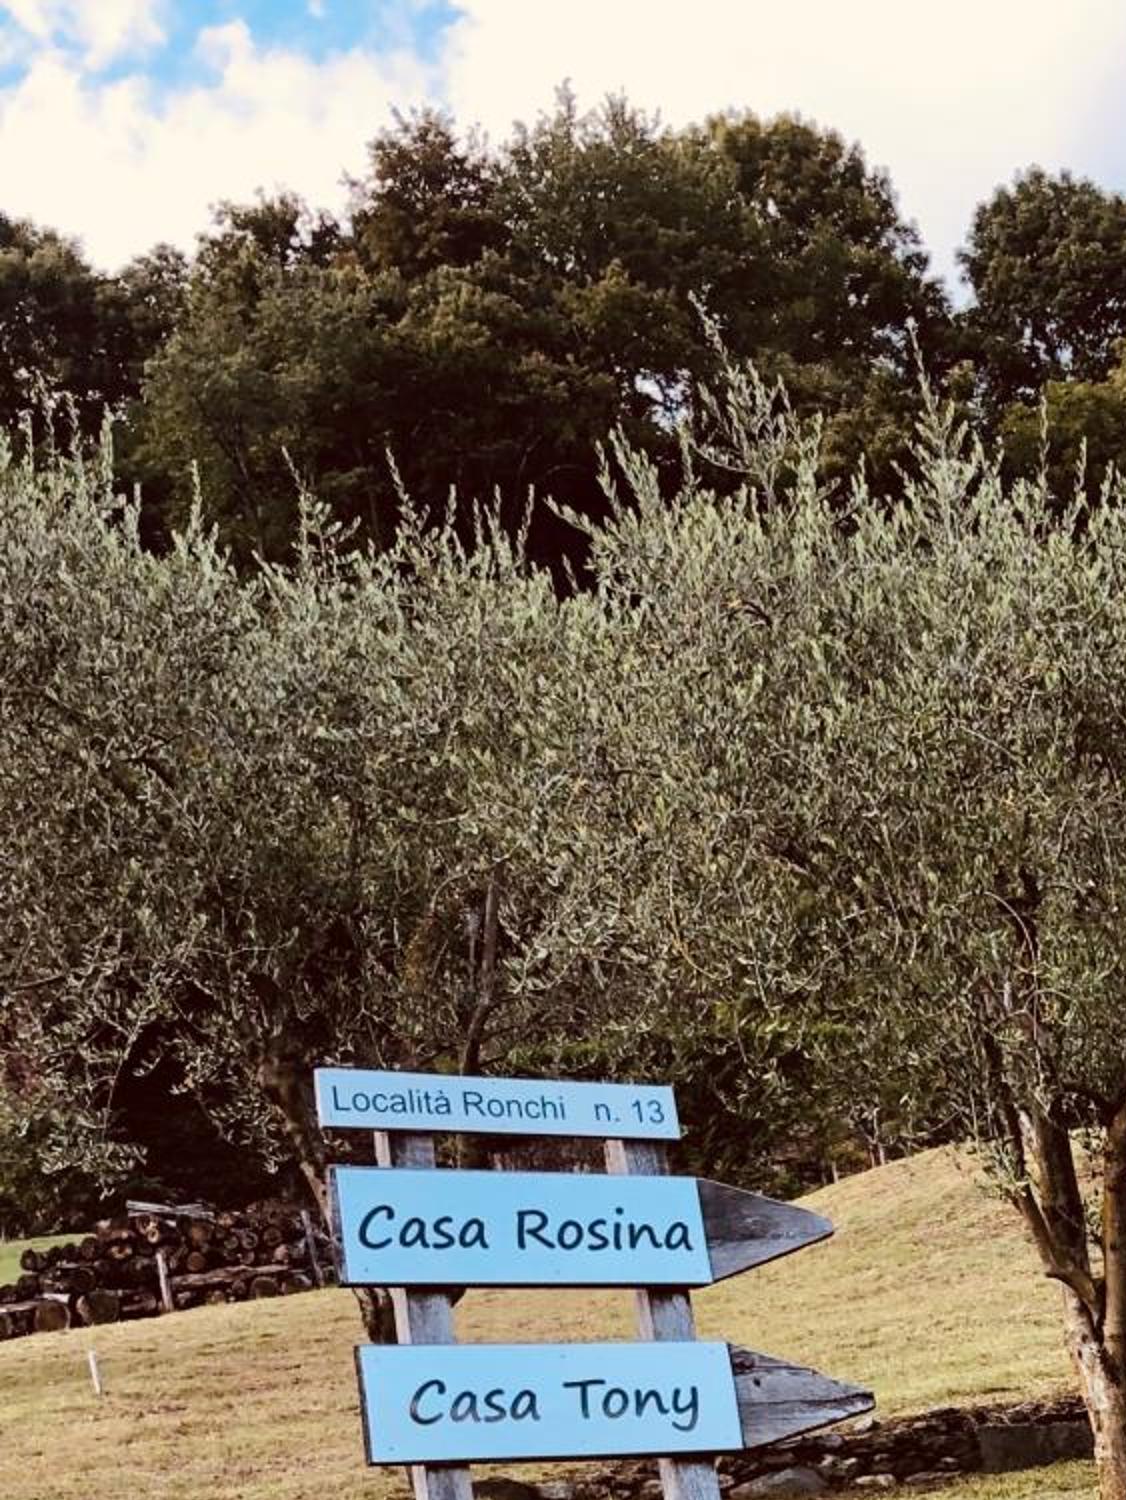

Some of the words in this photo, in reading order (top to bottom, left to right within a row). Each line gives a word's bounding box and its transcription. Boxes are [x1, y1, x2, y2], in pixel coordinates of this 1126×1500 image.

[332, 1086, 451, 1116] Località
[462, 1091, 566, 1121] Ronchi
[594, 1103, 621, 1123] n.
[632, 1099, 665, 1124] 13
[358, 1205, 489, 1250] Casa
[517, 1207, 694, 1251] Rosina
[410, 1379, 541, 1426] Casa
[562, 1379, 699, 1432] Tony
